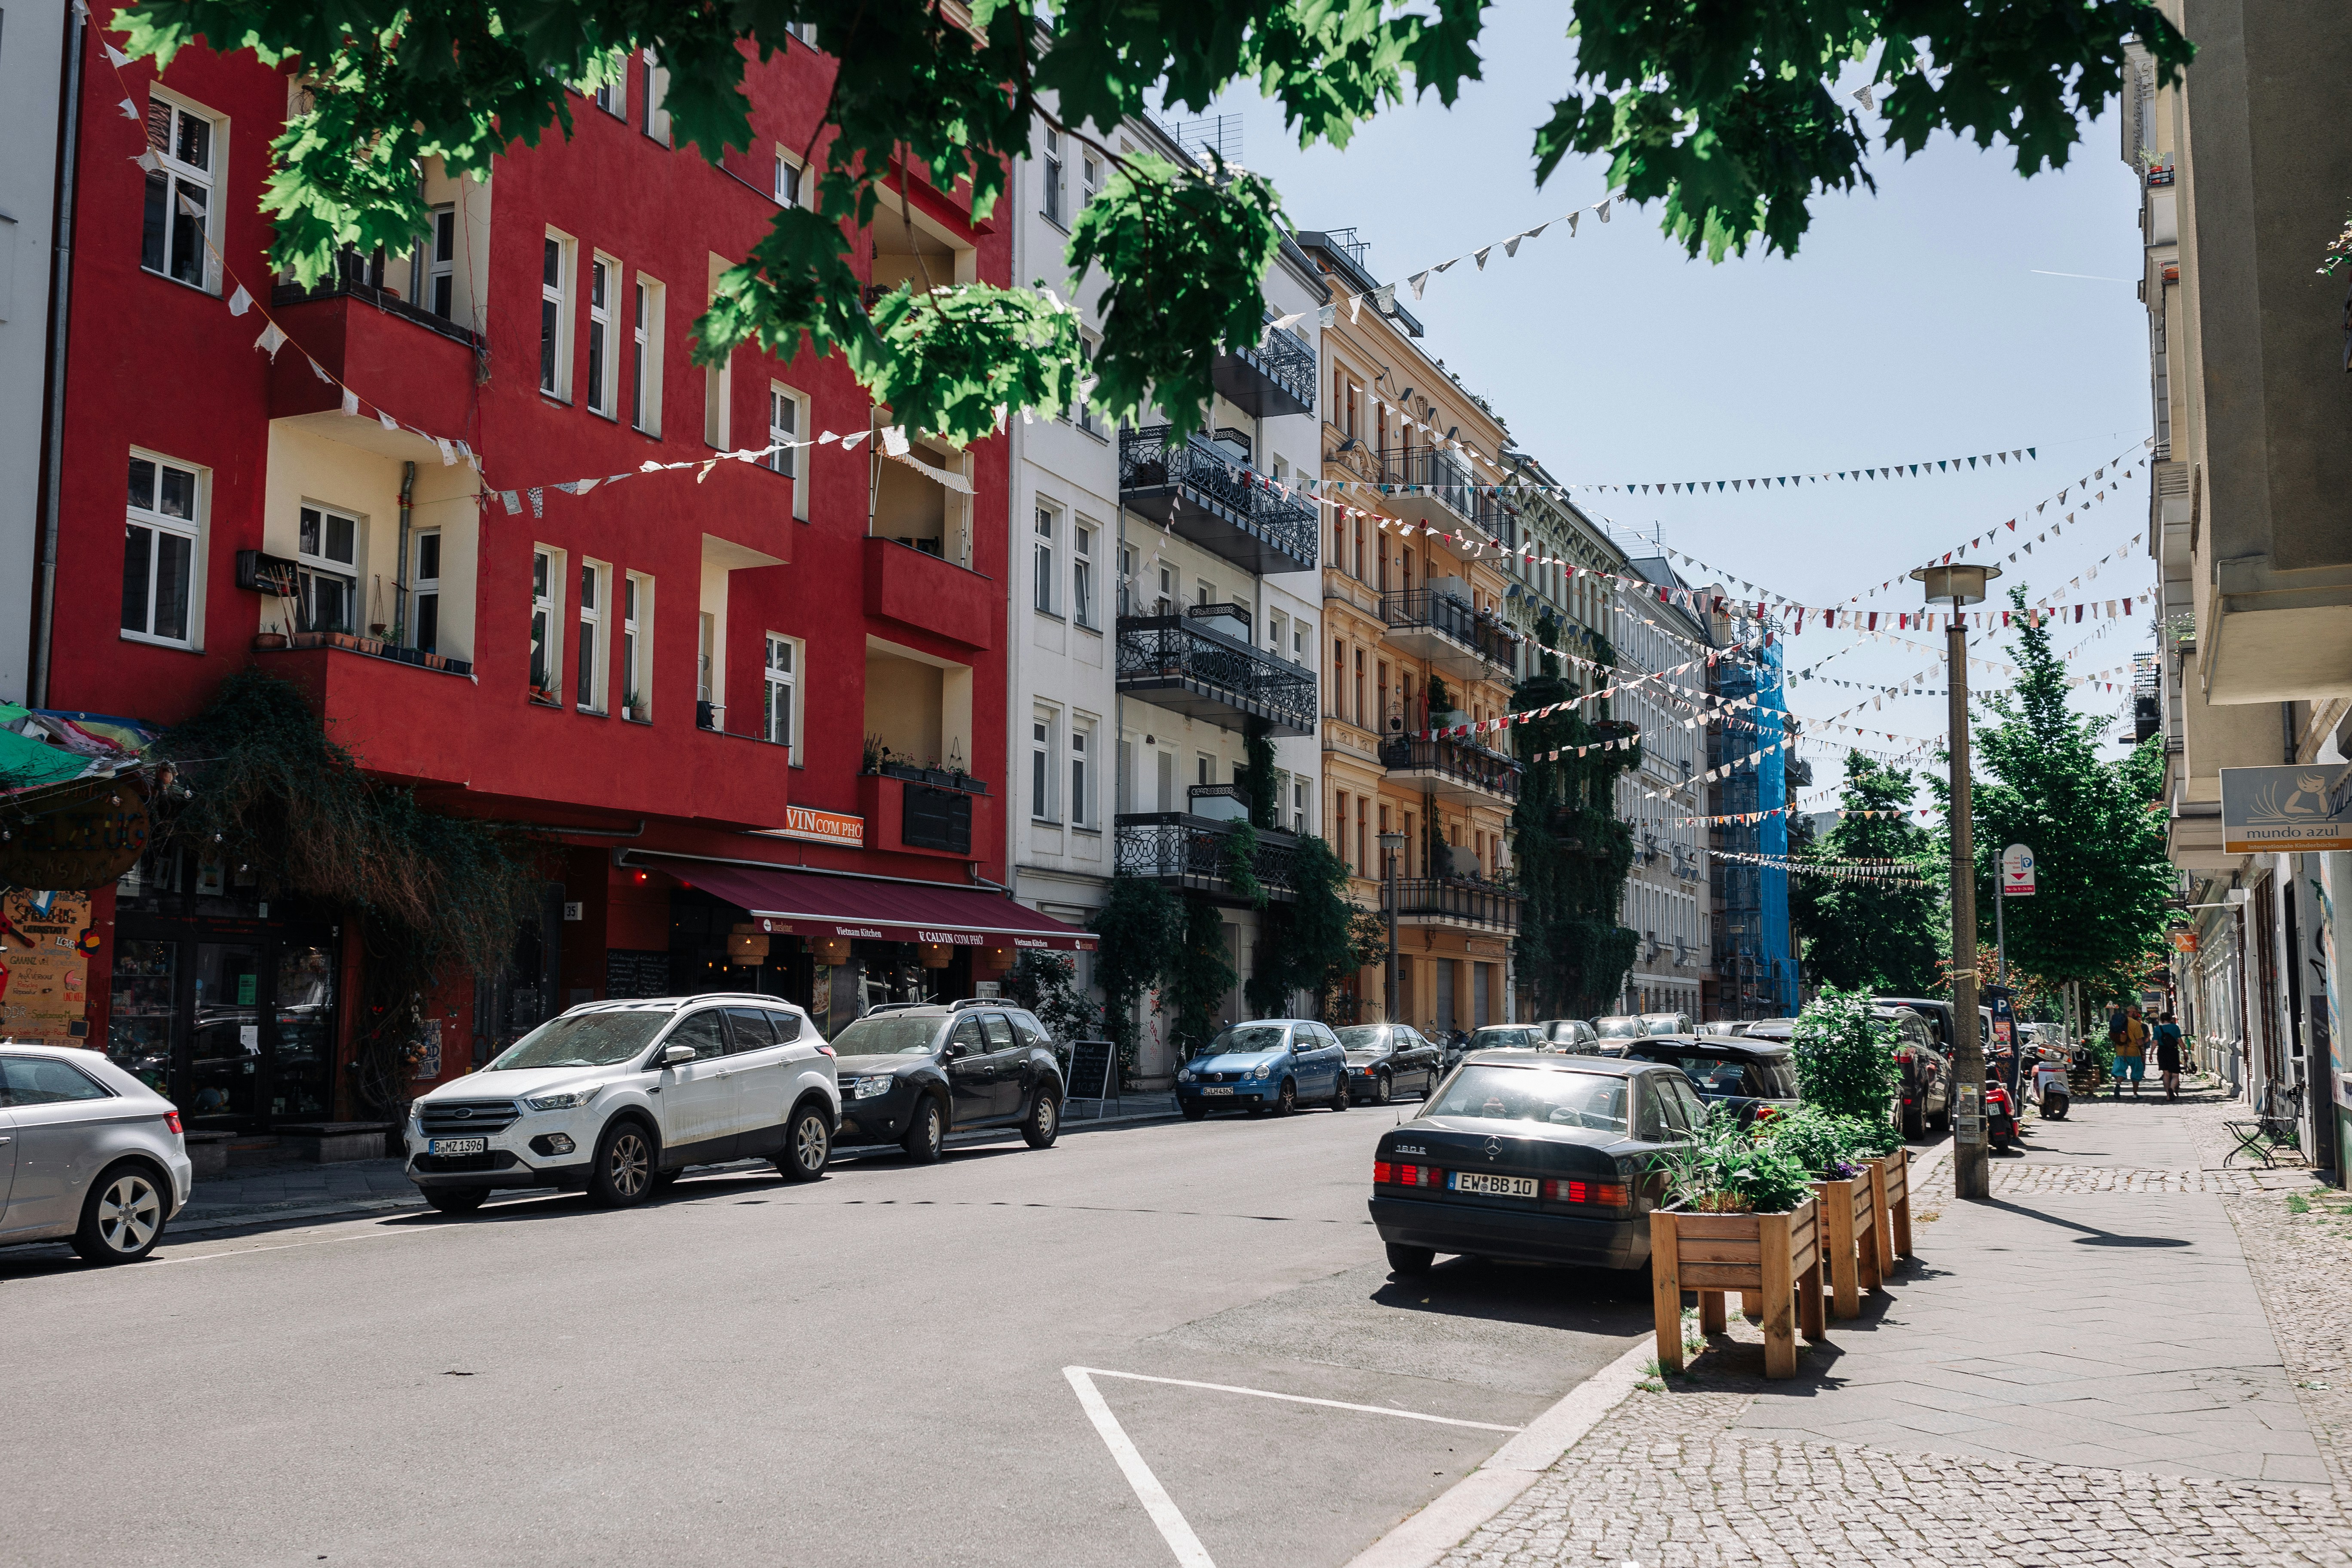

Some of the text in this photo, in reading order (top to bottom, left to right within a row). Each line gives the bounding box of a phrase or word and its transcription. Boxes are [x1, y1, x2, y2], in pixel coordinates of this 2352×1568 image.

[2247, 825, 2339, 838] mundo azul
[567, 906, 576, 917] 35
[836, 927, 860, 936] Vietnam
[860, 928, 882, 937] Kitchen
[926, 932, 953, 943] CALVIN
[1014, 938, 1032, 946] Vietnam
[1032, 939, 1048, 947] Kitchen
[1998, 1000, 2007, 1012] P
[435, 1140, 482, 1153] B MZ 1396
[1461, 1174, 1532, 1195] EW BB 10
